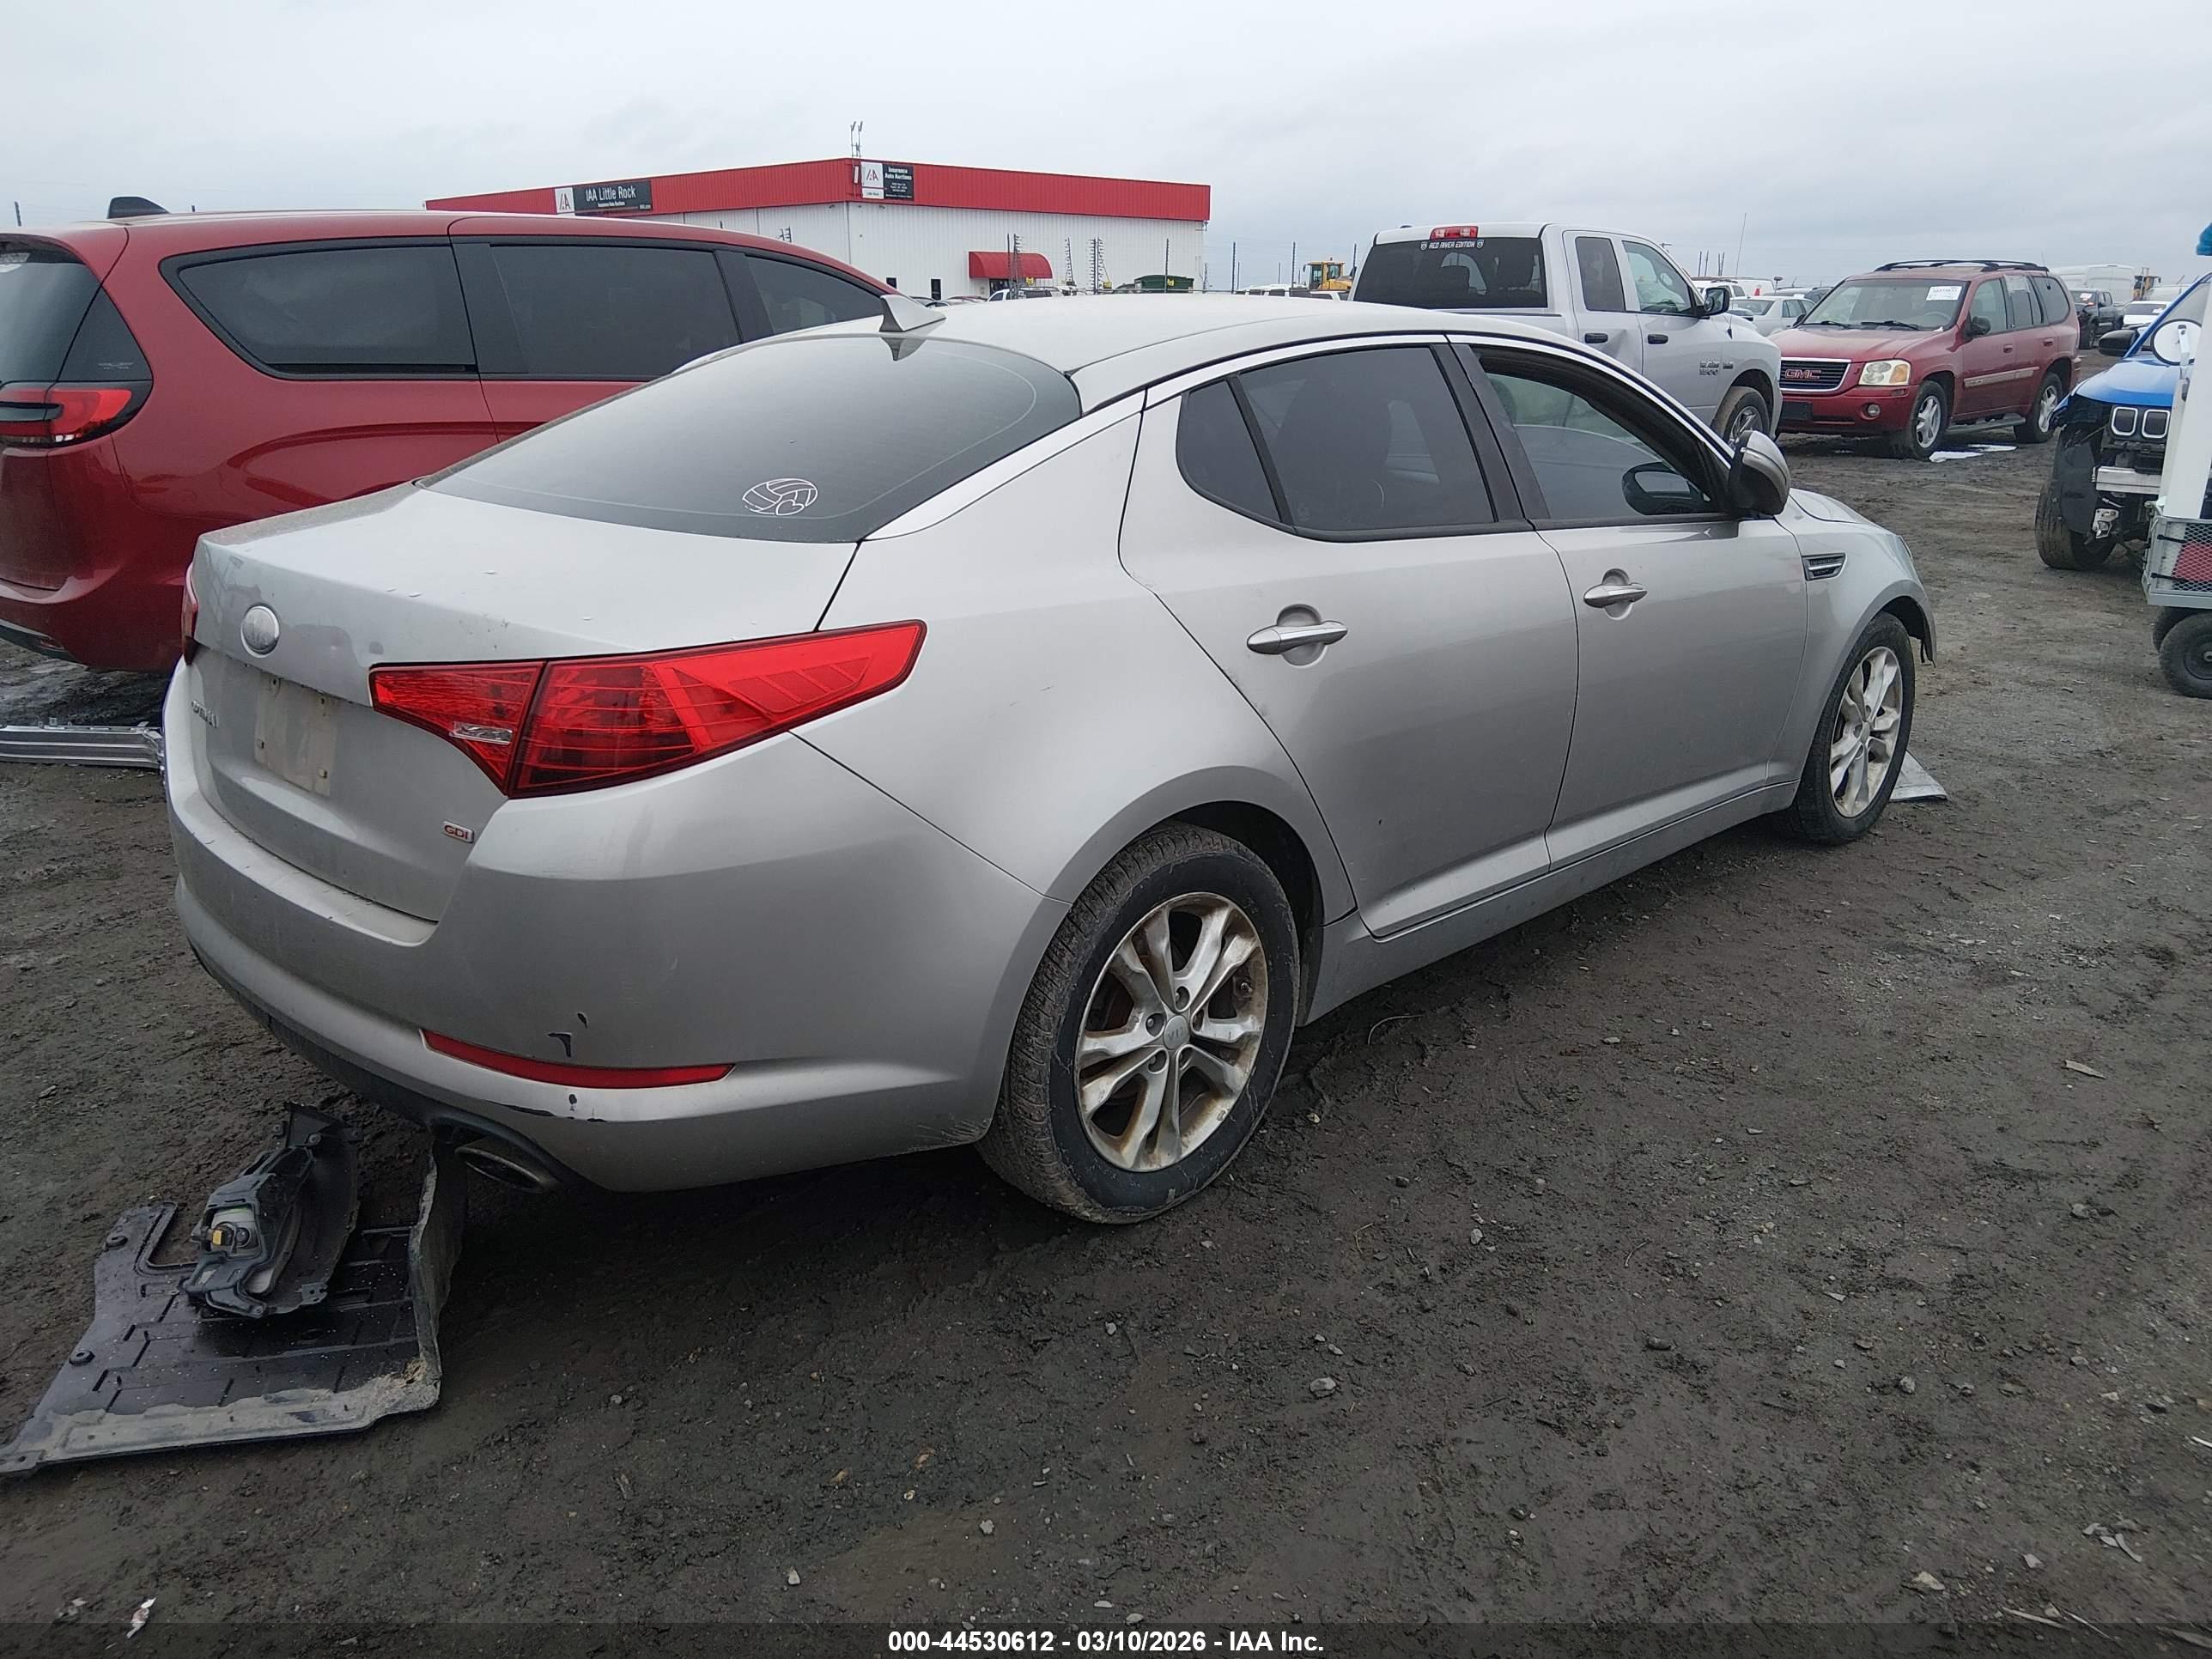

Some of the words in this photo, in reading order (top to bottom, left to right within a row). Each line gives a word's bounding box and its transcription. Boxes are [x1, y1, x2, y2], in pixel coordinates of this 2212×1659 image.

[586, 188, 598, 202] IAA
[599, 187, 617, 201] Little
[617, 185, 637, 199] Rock
[1439, 240, 1455, 249] RIVER
[1785, 368, 1821, 380] GMC
[444, 824, 469, 840] GDI
